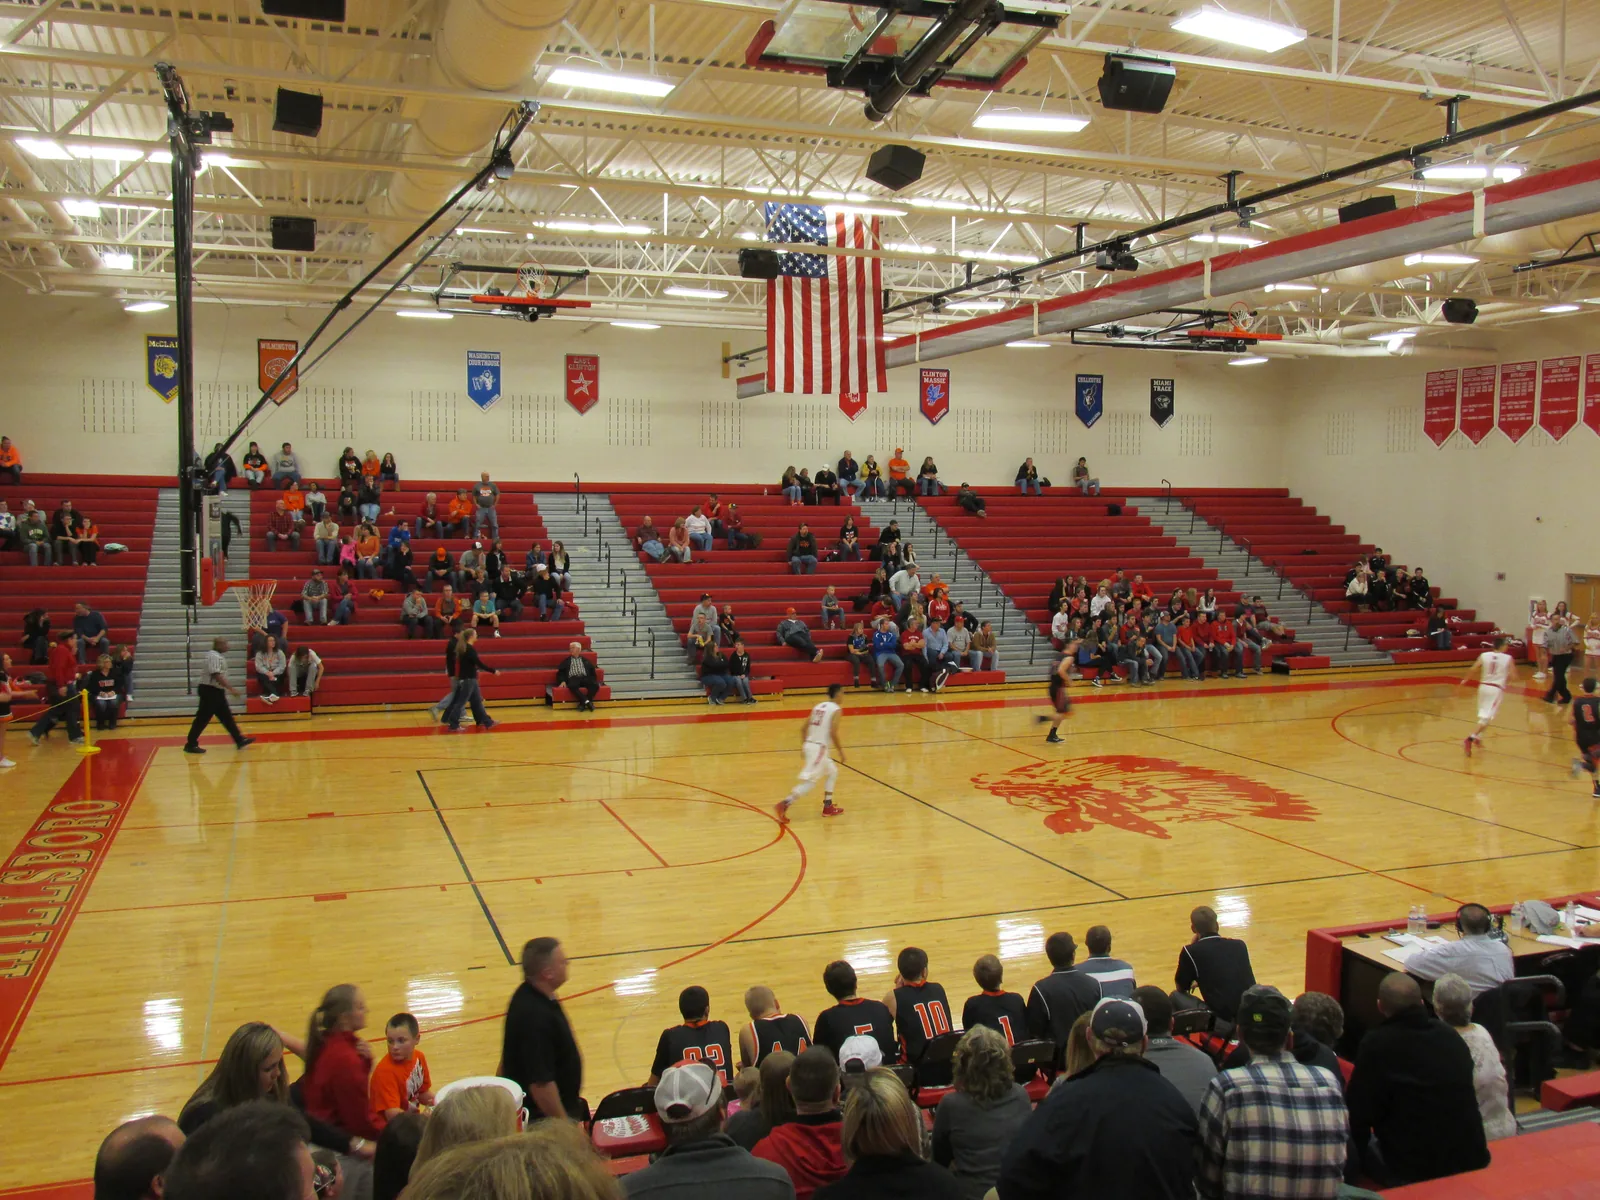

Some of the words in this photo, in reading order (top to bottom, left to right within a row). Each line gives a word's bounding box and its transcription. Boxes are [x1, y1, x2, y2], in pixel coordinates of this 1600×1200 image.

[148, 340, 178, 348] McCLAI
[260, 342, 296, 350] WILMINGTON
[469, 352, 500, 360] WASHINGTON
[469, 359, 500, 367] COURTHOUSE
[568, 363, 597, 371] CLINTON
[913, 1000, 951, 1040] 10
[997, 1015, 1015, 1048] 1
